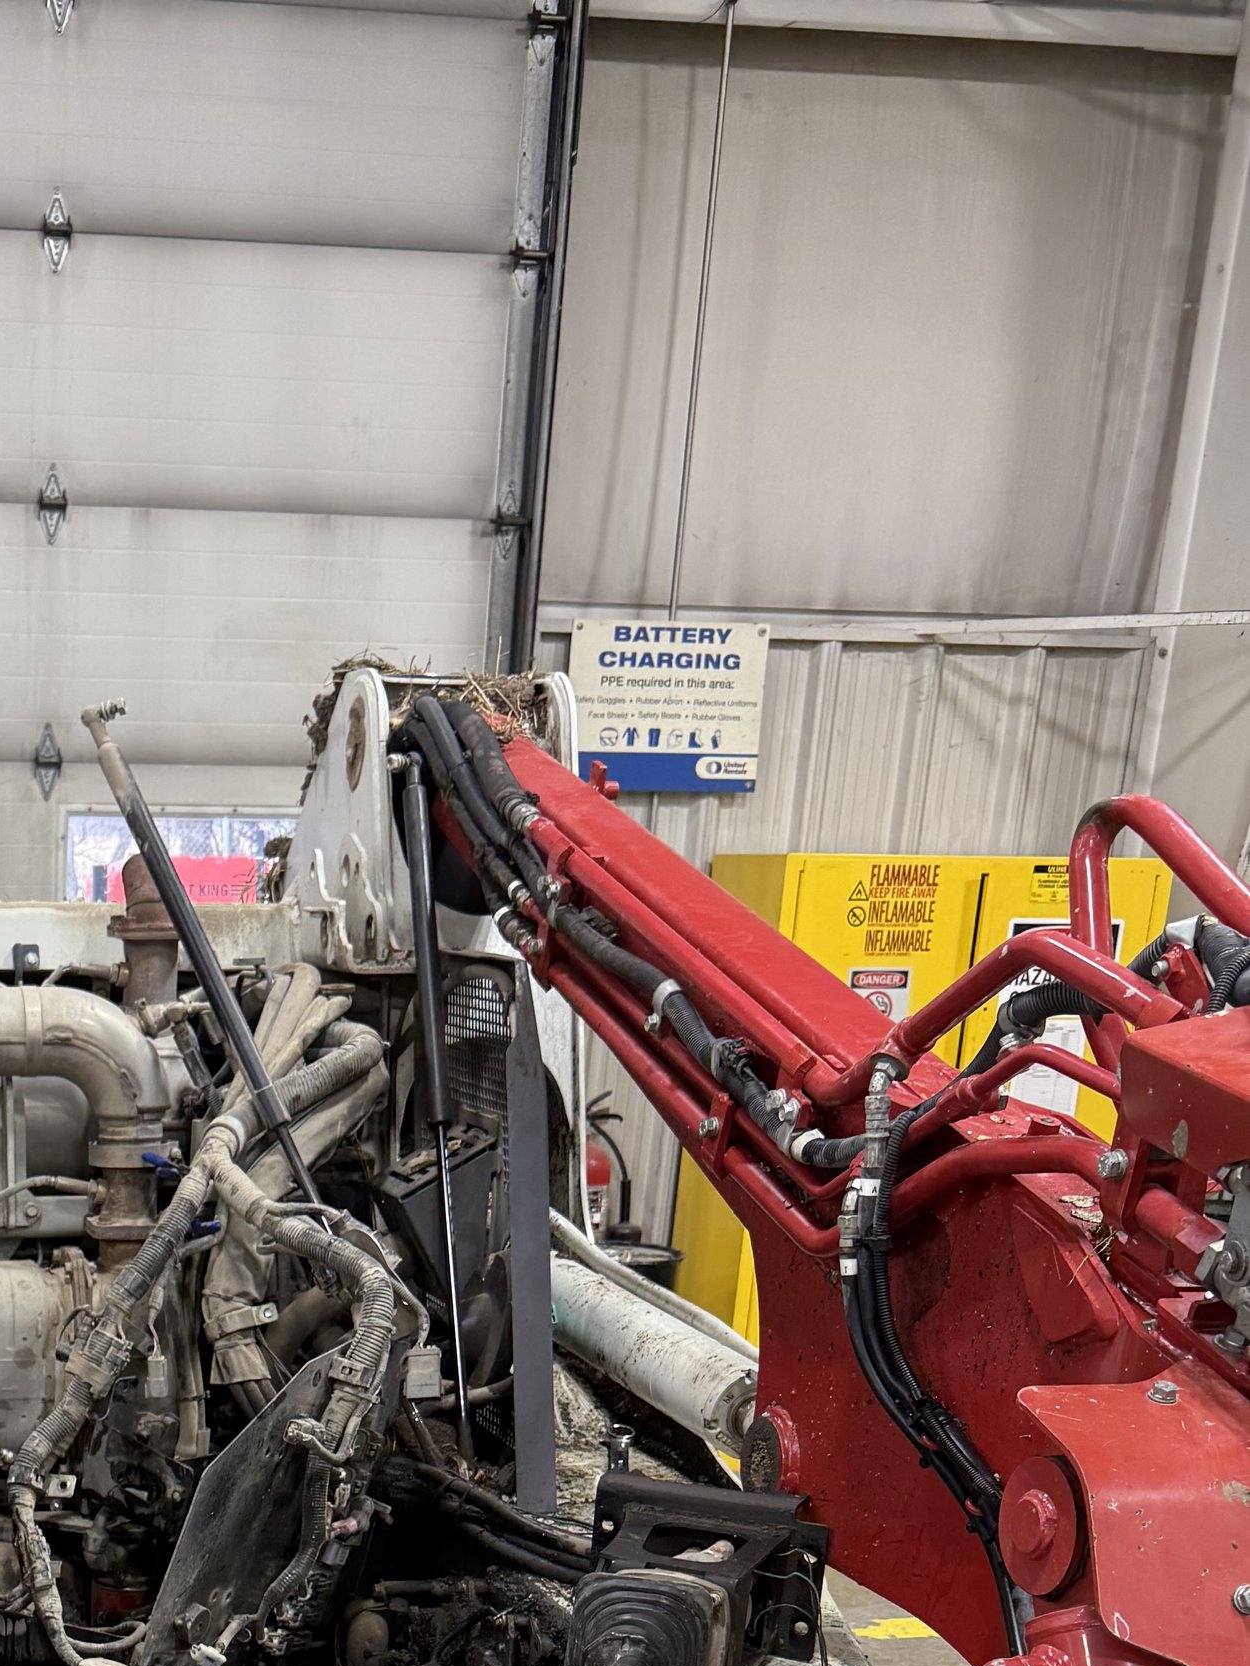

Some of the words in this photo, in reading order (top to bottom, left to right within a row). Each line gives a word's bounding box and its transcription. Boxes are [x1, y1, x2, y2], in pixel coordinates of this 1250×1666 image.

[614, 626, 732, 644] BATTERY
[598, 651, 740, 670] CHARGING
[600, 676, 624, 687] PPE
[626, 677, 671, 689] required
[674, 679, 684, 688] in
[687, 679, 706, 688] this
[709, 681, 735, 689] area:
[638, 712, 659, 720] Safety
[870, 864, 940, 887] FLAMMABLE
[199, 884, 228, 897] KING
[869, 887, 890, 899] KEEP
[891, 887, 910, 899] FIRE
[911, 888, 937, 899] AWAY
[867, 901, 936, 923] INFLAMABLE
[864, 930, 933, 952] INFLAMMABLE
[859, 975, 901, 985] DANGER
